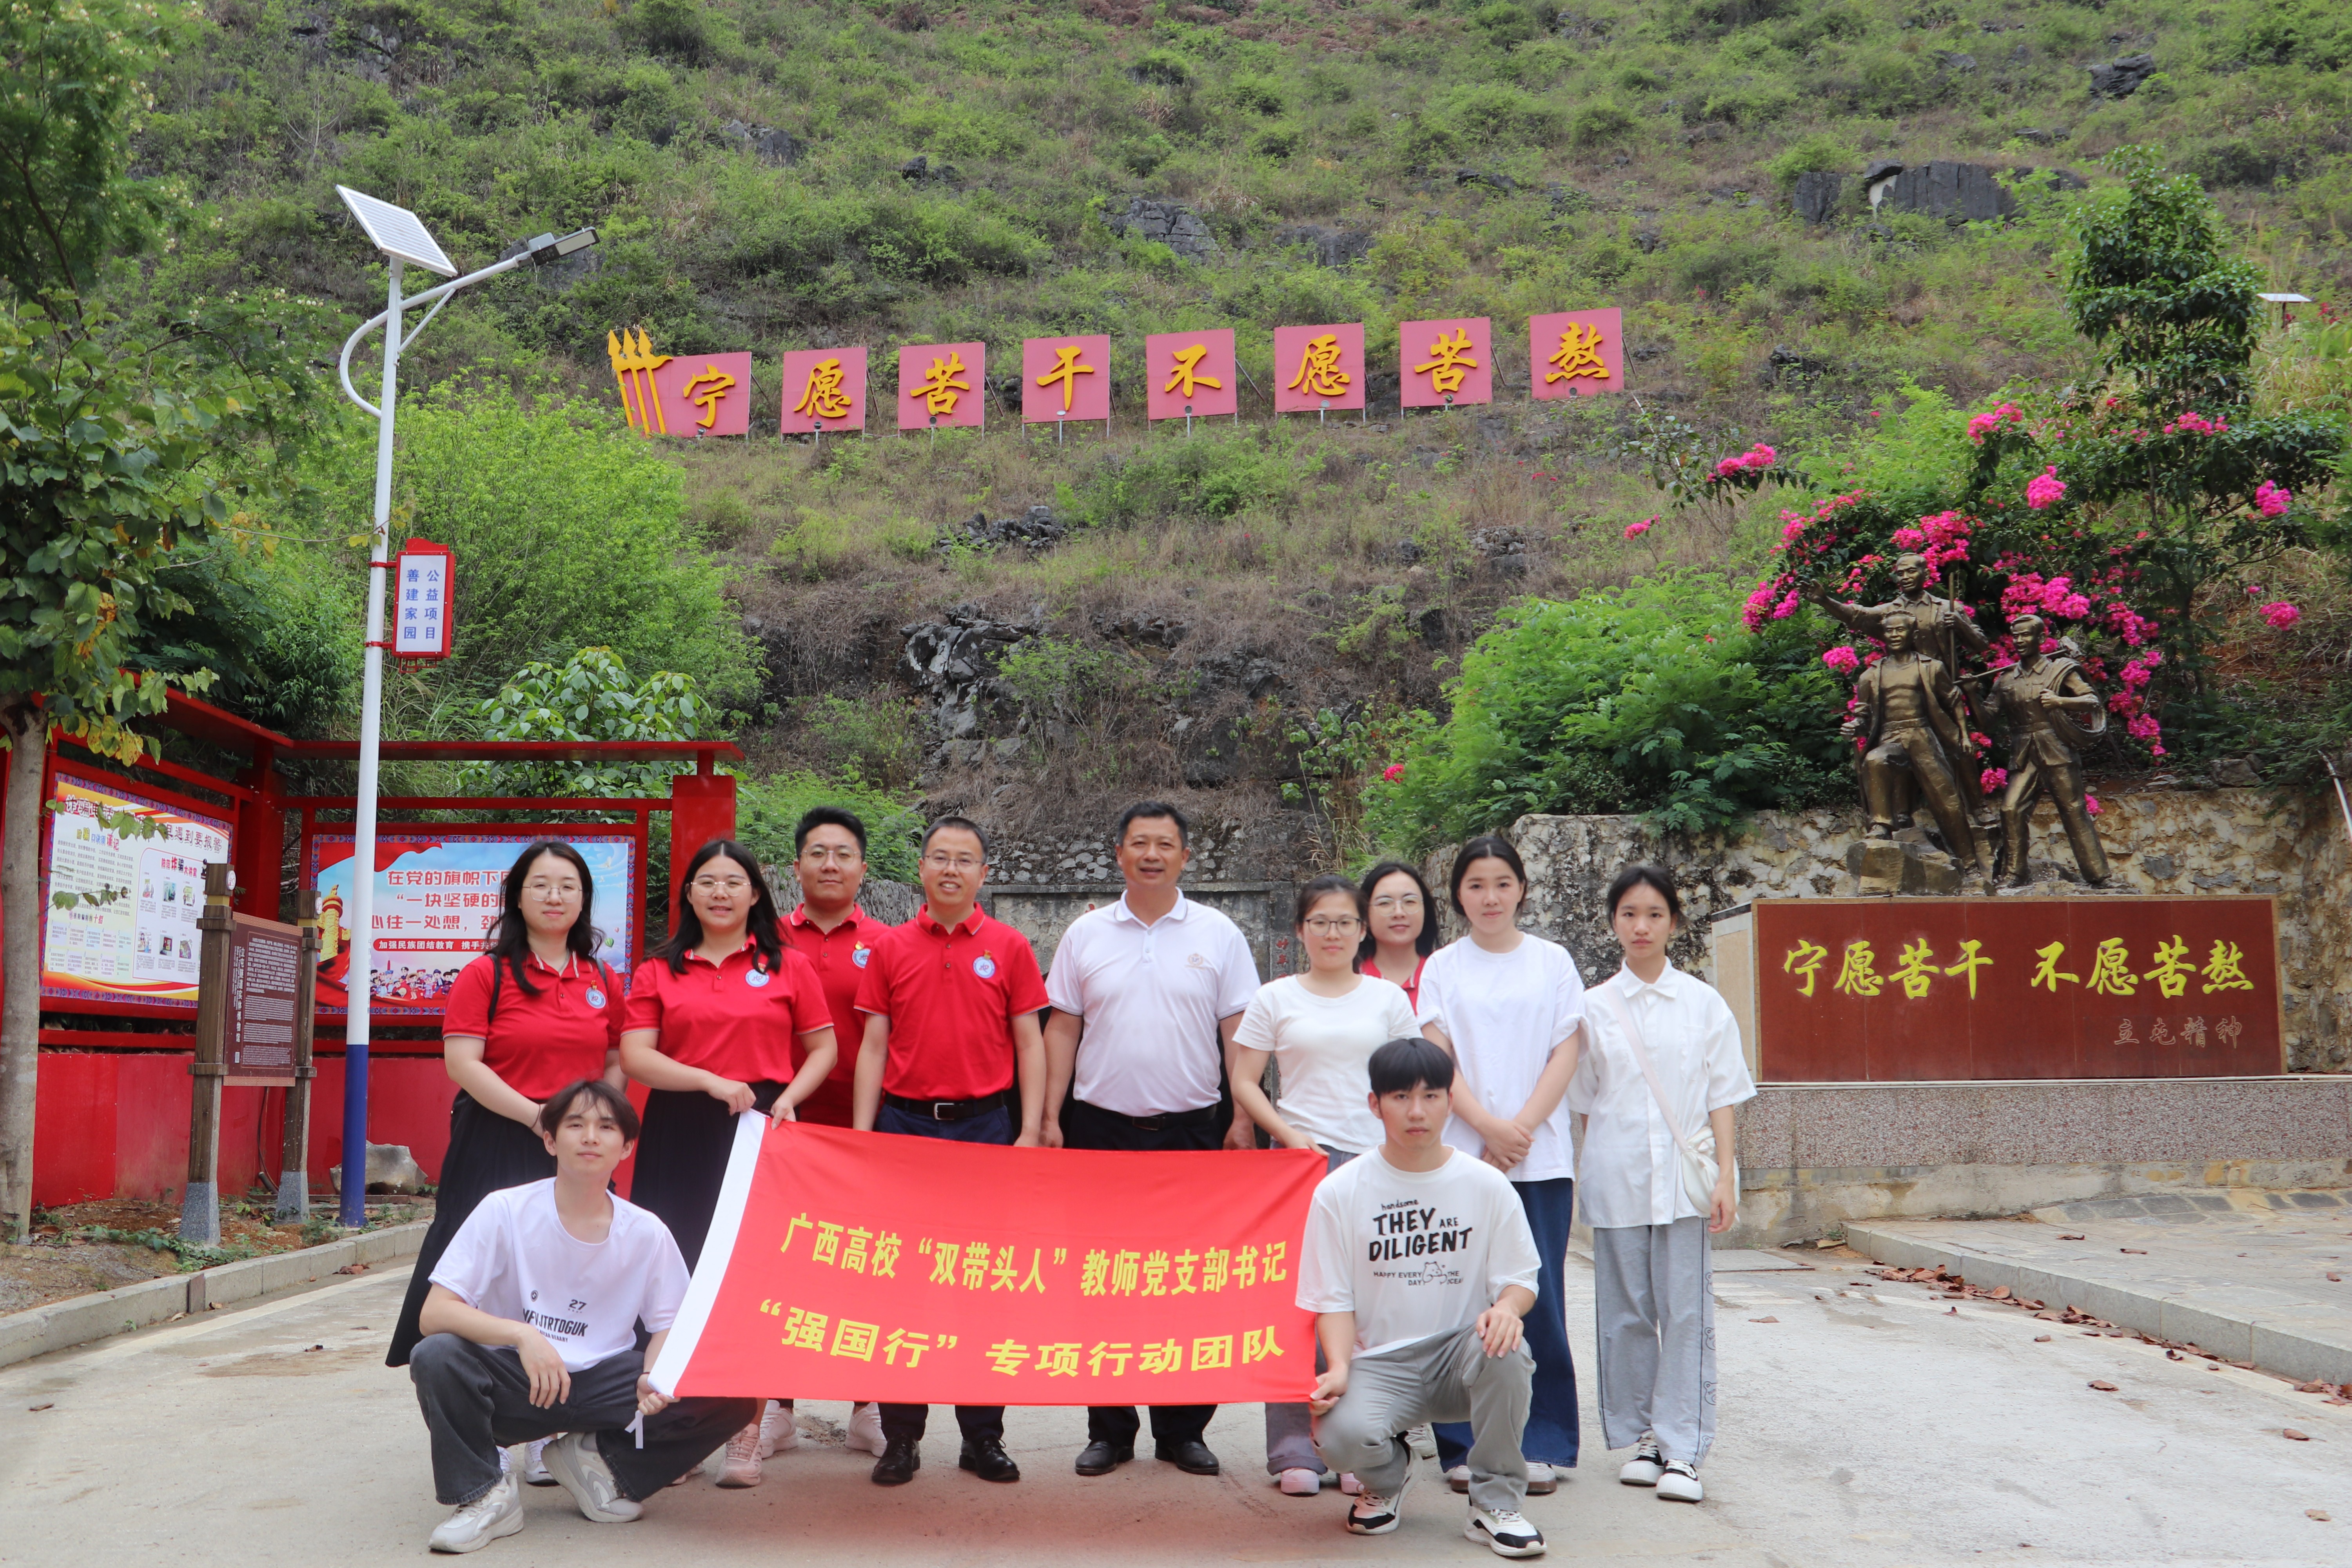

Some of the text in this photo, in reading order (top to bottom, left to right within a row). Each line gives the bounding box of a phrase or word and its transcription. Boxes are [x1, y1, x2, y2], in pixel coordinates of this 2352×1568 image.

[404, 569, 419, 639] 善建家园
[424, 570, 439, 639] 公益项目
[161, 857, 197, 877] 防范诈骗大讲堂
[379, 941, 454, 950] 加强民族团结教育
[1784, 935, 2254, 1000] 宁愿苦干 不愿苦熬
[1381, 1199, 1419, 1210] handsome
[1373, 1208, 1459, 1235] THEY ARE
[1369, 1227, 1473, 1261] DILIGENT
[569, 1299, 587, 1310] 27
